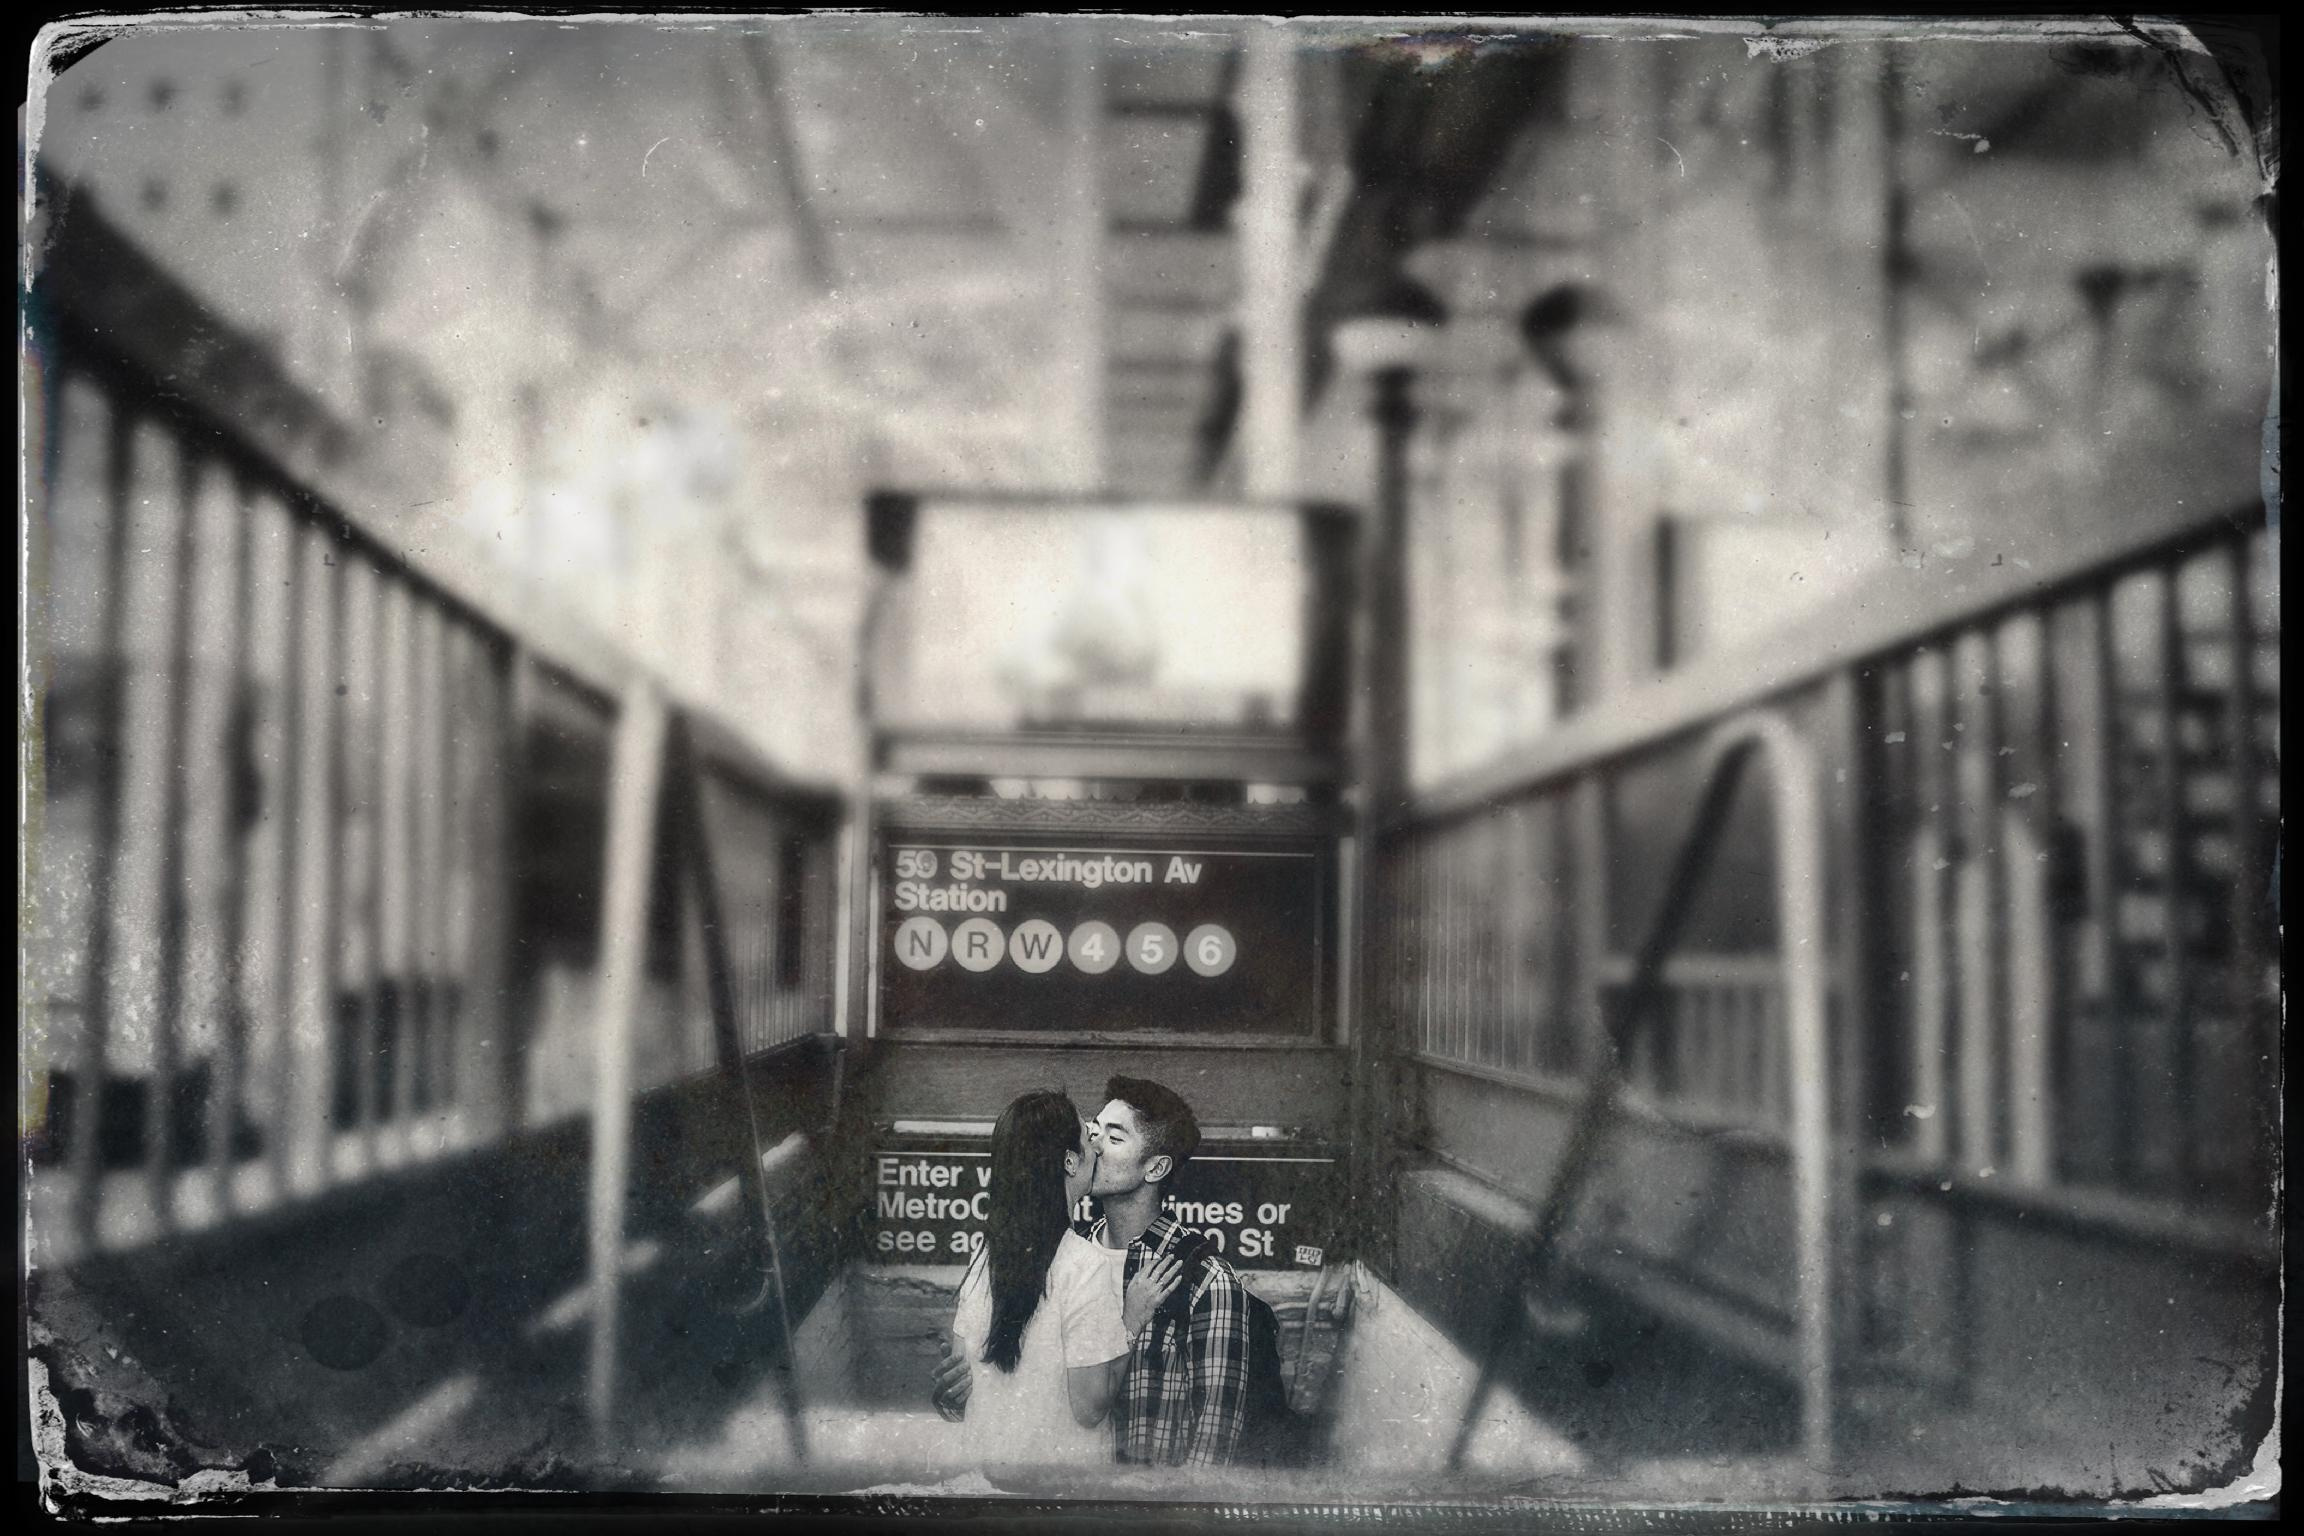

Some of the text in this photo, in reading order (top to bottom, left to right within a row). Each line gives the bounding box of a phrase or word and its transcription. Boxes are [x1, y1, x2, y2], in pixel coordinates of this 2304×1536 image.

[950, 851, 1153, 888] St-Lexington
[1164, 856, 1202, 884] Av
[894, 881, 1008, 912] Station
[909, 929, 1222, 966] N R W 4 5 6
[877, 1158, 964, 1188] Enter
[877, 1191, 991, 1221] MetroC
[1257, 1202, 1292, 1225] or
[877, 1230, 937, 1253] see
[1238, 1227, 1275, 1257] St
